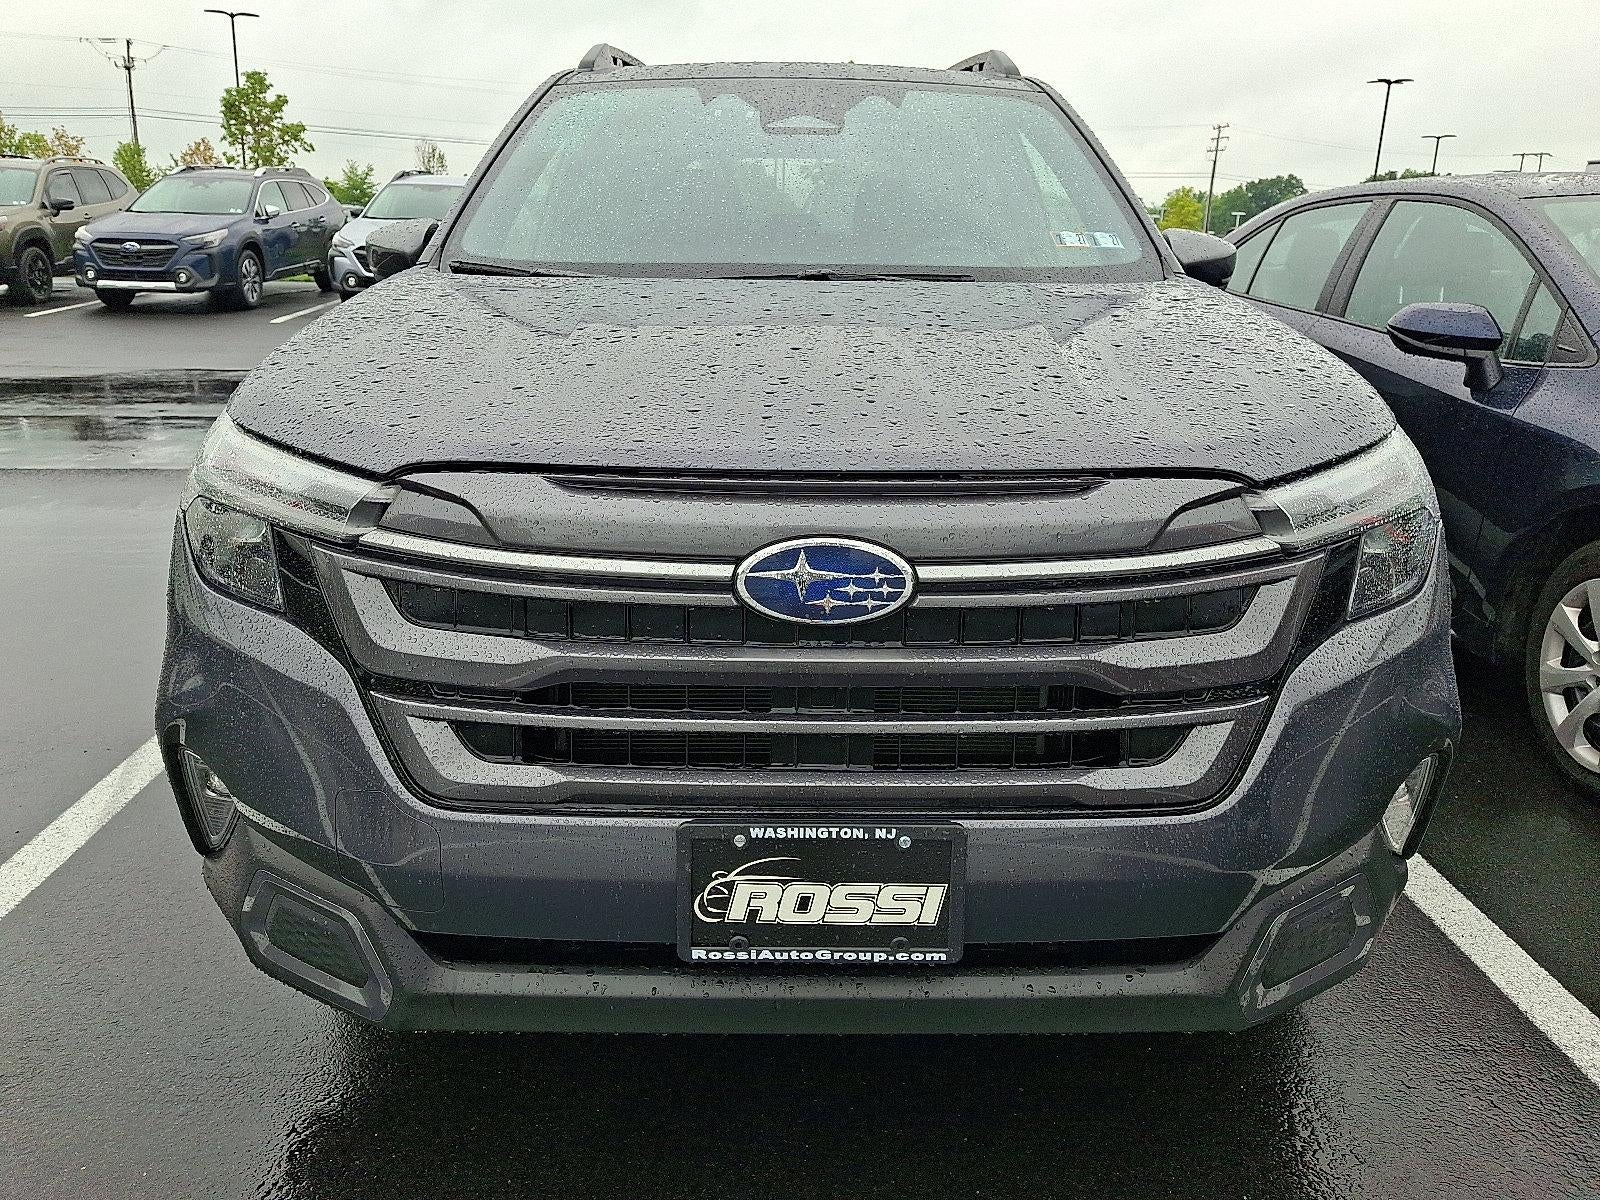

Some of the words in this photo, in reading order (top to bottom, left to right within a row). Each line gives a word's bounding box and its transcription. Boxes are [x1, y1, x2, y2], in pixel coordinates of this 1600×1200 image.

[749, 827, 869, 840] WASHINGTON,
[875, 828, 897, 840] NJ
[724, 881, 949, 926] ROSSI
[691, 949, 947, 961] RossiAutoGroup.com
